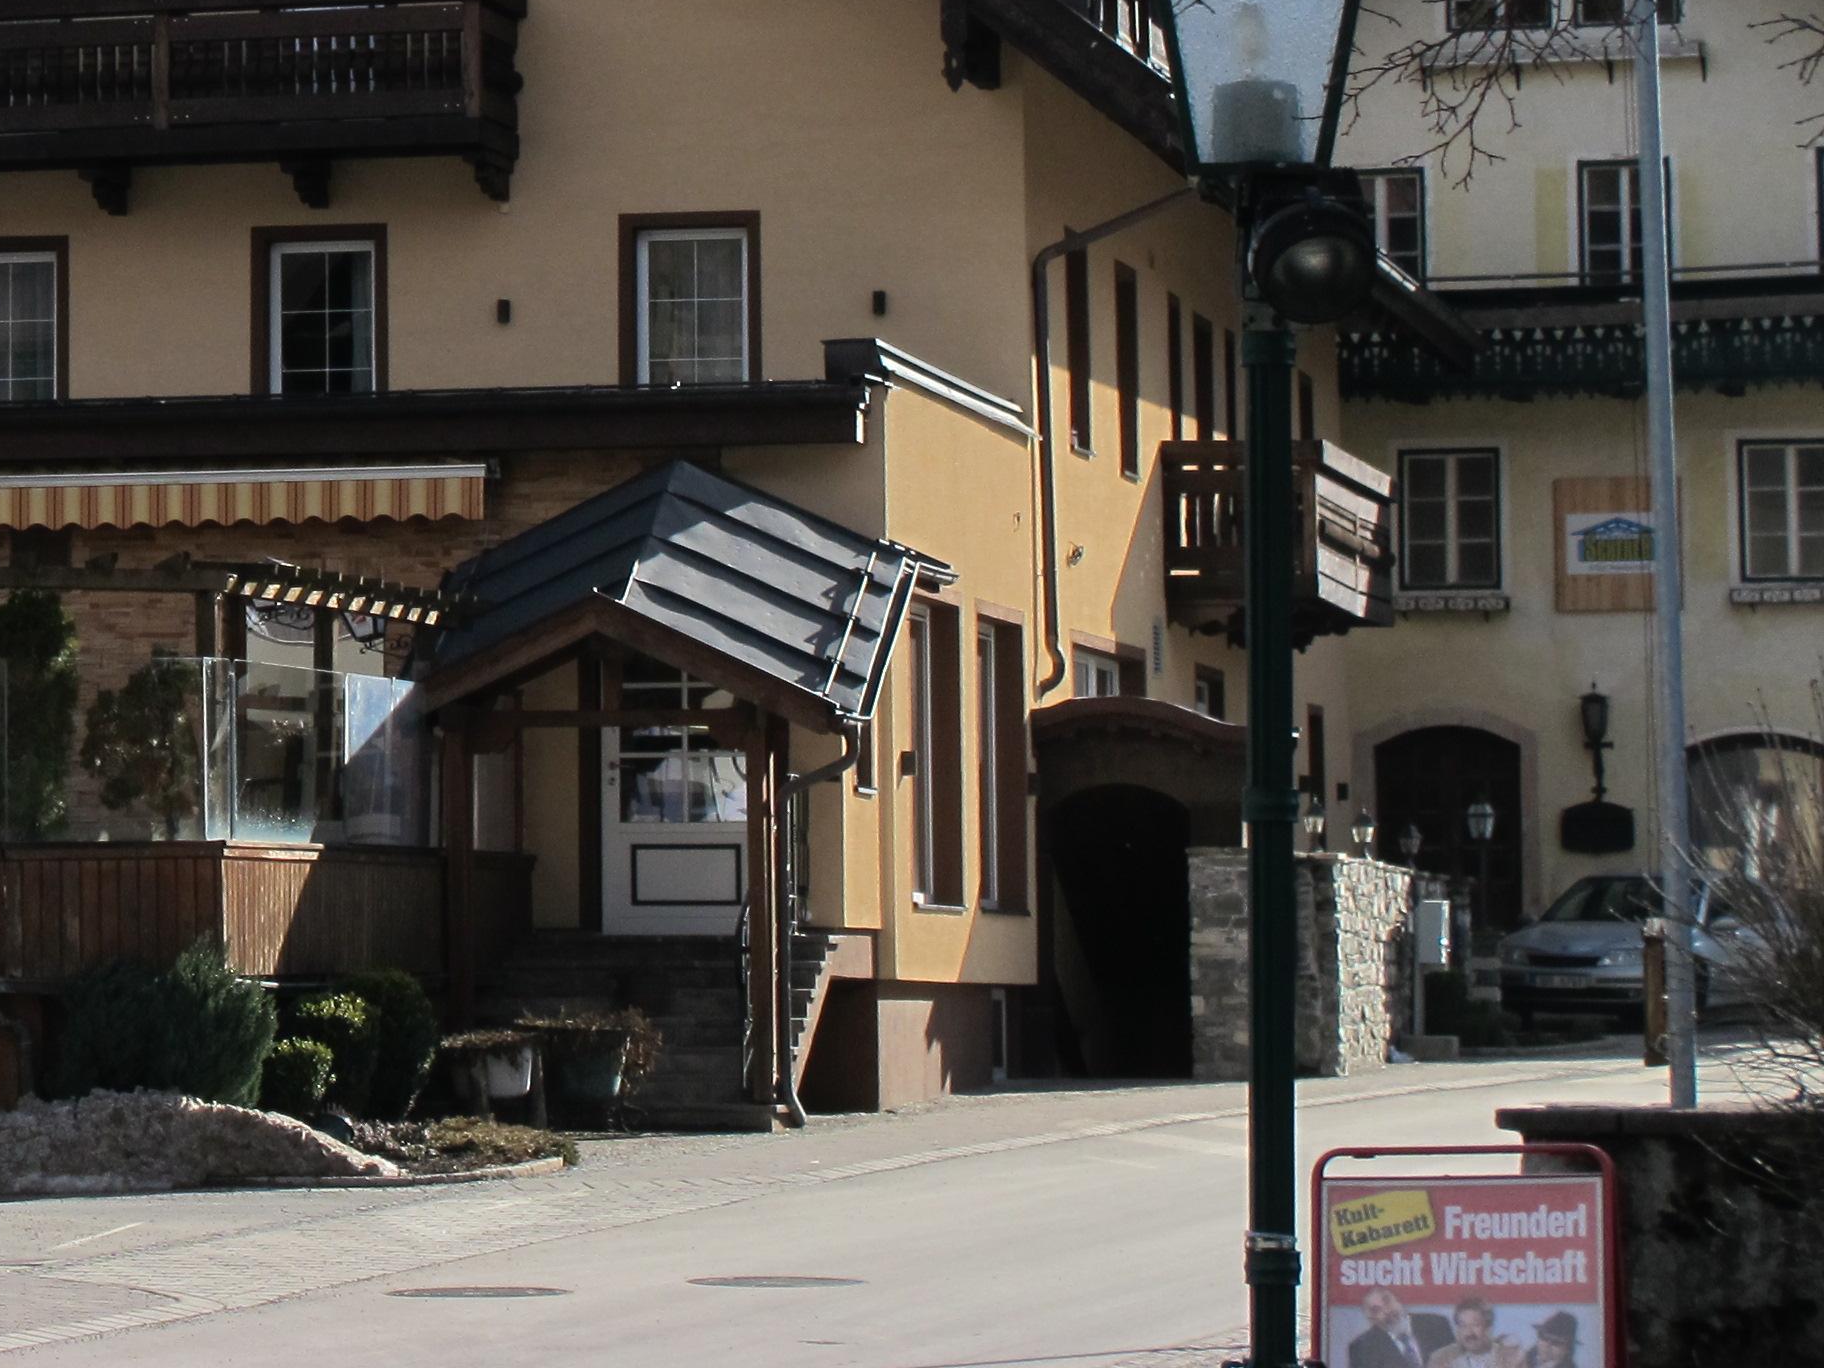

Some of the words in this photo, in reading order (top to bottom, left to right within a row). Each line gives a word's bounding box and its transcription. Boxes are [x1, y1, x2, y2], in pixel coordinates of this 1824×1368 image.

[1334, 1203, 1385, 1227] Kult-
[1340, 1214, 1430, 1249] Kabarett
[1444, 1203, 1588, 1240] Freunderl
[1340, 1252, 1424, 1286] sucht
[1429, 1249, 1588, 1286] Wirtschaft
